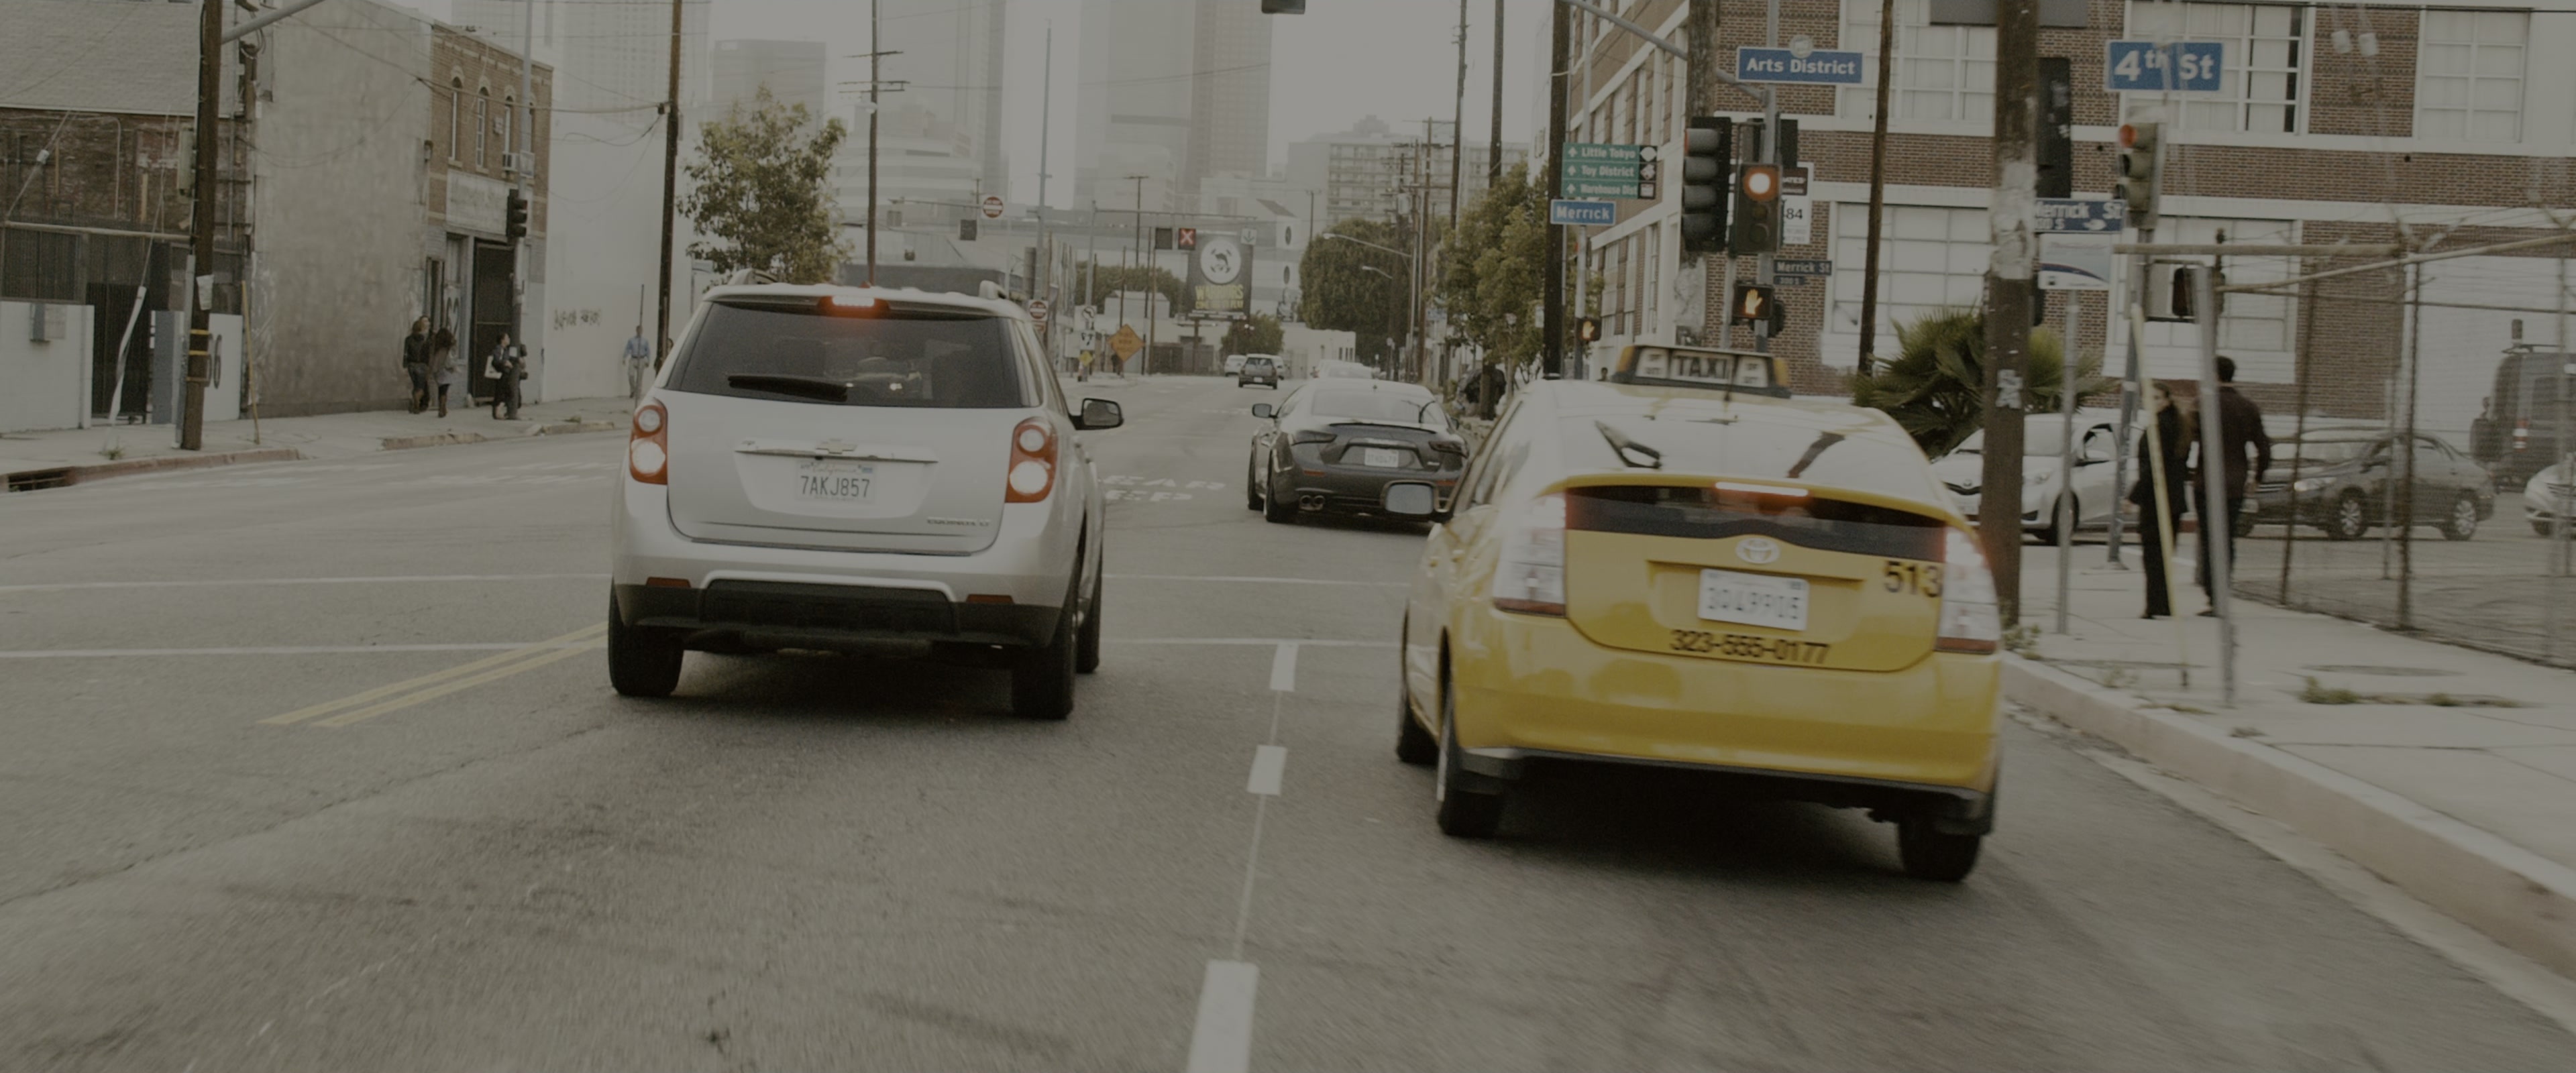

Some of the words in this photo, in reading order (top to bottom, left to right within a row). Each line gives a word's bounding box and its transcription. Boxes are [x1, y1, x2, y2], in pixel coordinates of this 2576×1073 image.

[1746, 58, 1784, 72] Arts
[1790, 59, 1856, 74] District
[2114, 49, 2170, 81] 4th
[2180, 53, 2214, 80] St
[1581, 147, 1607, 158] Little
[1609, 148, 1635, 160] Tokyo
[1582, 165, 1597, 177] Toy
[1599, 166, 1634, 177] District
[1580, 184, 1621, 194] Warehouse
[1556, 206, 1609, 219] Merrick
[2102, 202, 2123, 219] St
[1777, 262, 1815, 272] Merrick
[1819, 262, 1830, 274] St
[1673, 355, 1728, 380] TAXI
[800, 475, 870, 498] 7AKJ857
[1102, 475, 1226, 490] EAR
[1884, 561, 1943, 598] 513
[1670, 629, 1830, 665] 323-555-0177
